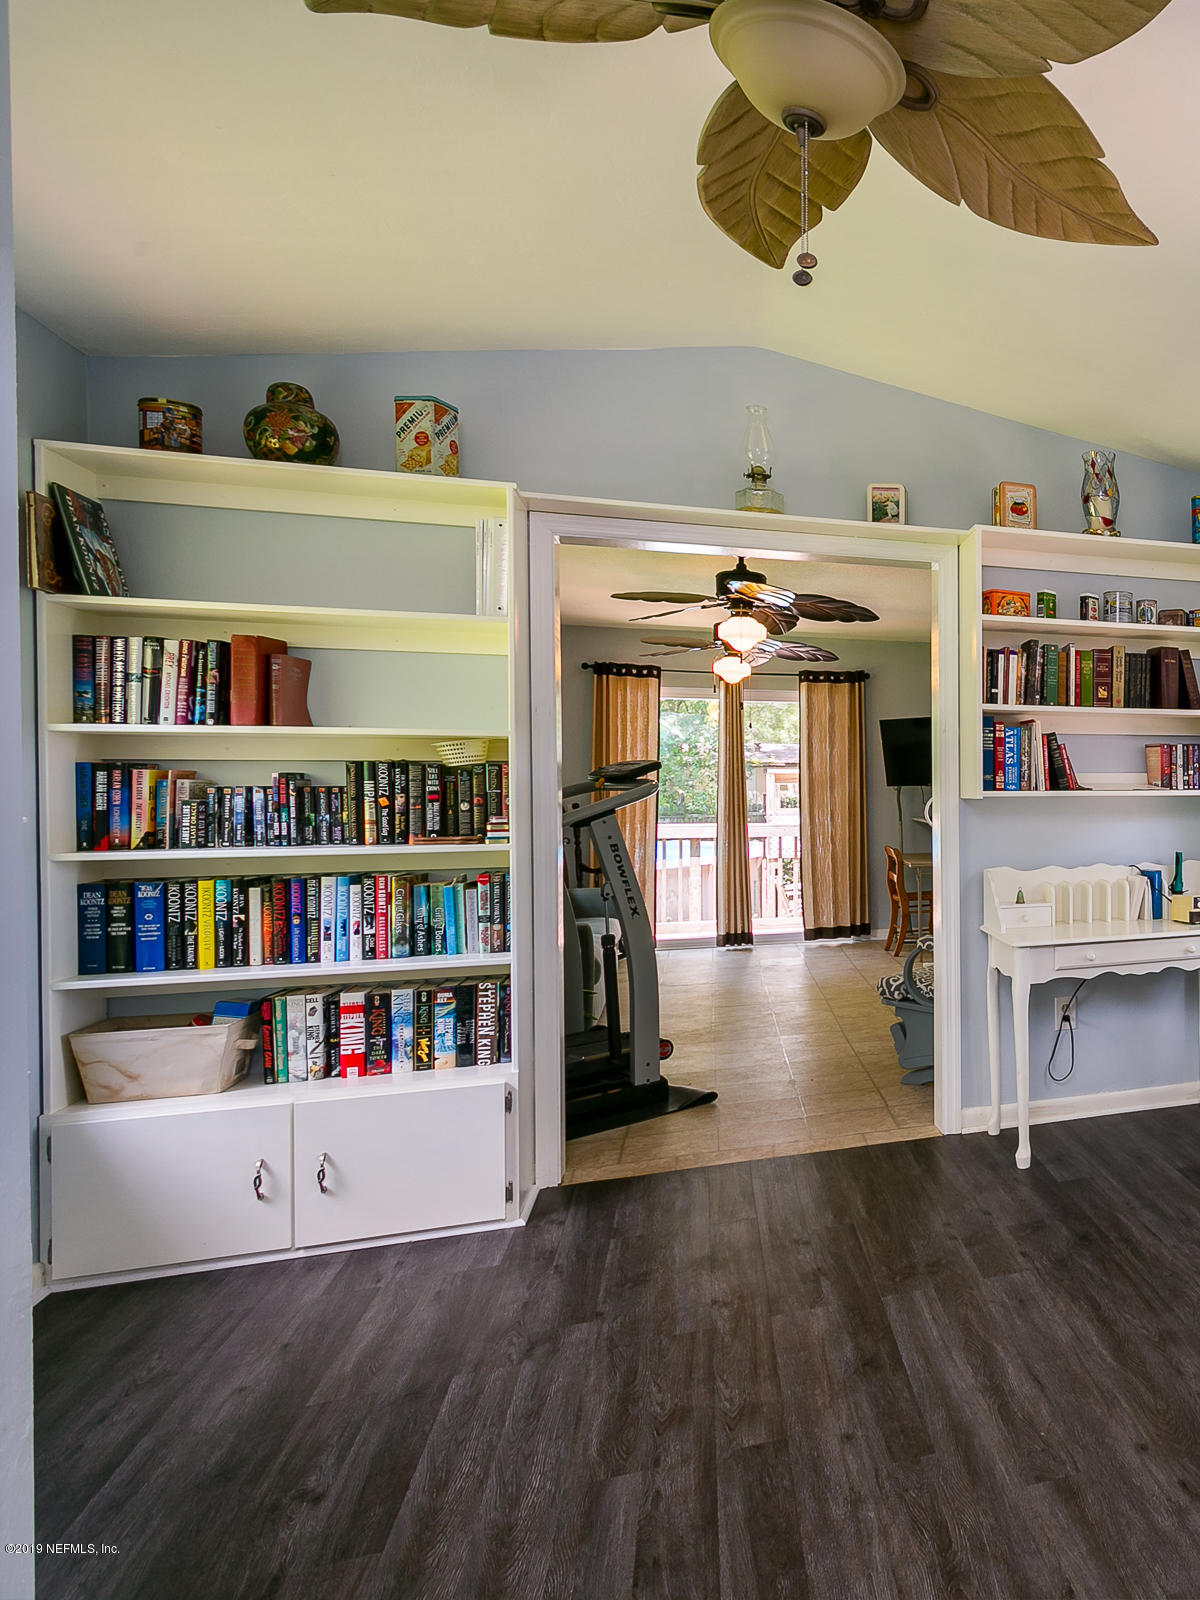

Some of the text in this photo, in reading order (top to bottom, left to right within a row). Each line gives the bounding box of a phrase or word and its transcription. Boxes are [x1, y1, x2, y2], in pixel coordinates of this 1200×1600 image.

[395, 405, 428, 439] PREMIU
[65, 494, 100, 591] DEAN KOONTZ
[165, 652, 176, 669] PREY
[1005, 728, 1014, 765] ATLAS
[96, 771, 107, 792] HARLAN
[112, 770, 122, 789] HARLAN
[379, 767, 389, 796] KOONTZ
[608, 843, 640, 917] BOWFLEX
[168, 887, 181, 923] KOONTZ
[185, 886, 197, 921] KOONTZ
[202, 889, 212, 919] KOONTZ
[216, 886, 228, 922] KOONTZ
[274, 886, 286, 920] KOONTZ
[292, 885, 301, 913] KOONTZ
[307, 879, 316, 919] DEAN KOONTZ
[323, 886, 333, 917] KOONTZ
[338, 888, 348, 918] KOONTZ
[352, 892, 361, 920] KOONTZ
[364, 881, 375, 914] KOONTZ
[378, 889, 386, 913] KOONTZ
[394, 888, 405, 905] City
[264, 902, 273, 932] KOONTZ
[395, 912, 405, 934] Glass
[415, 907, 424, 923] City
[433, 907, 443, 923] City
[417, 930, 426, 952] Ashes
[434, 930, 444, 952] Bones
[368, 1008, 386, 1036] KING
[393, 994, 404, 1024] KING
[403, 993, 411, 1024] STEPHEN
[420, 1006, 429, 1023] KING
[306, 1025, 315, 1041] KING
[341, 1020, 365, 1054] KING
[445, 1018, 454, 1046] STEPHEN
[477, 983, 491, 1066] STEPHEN KING
